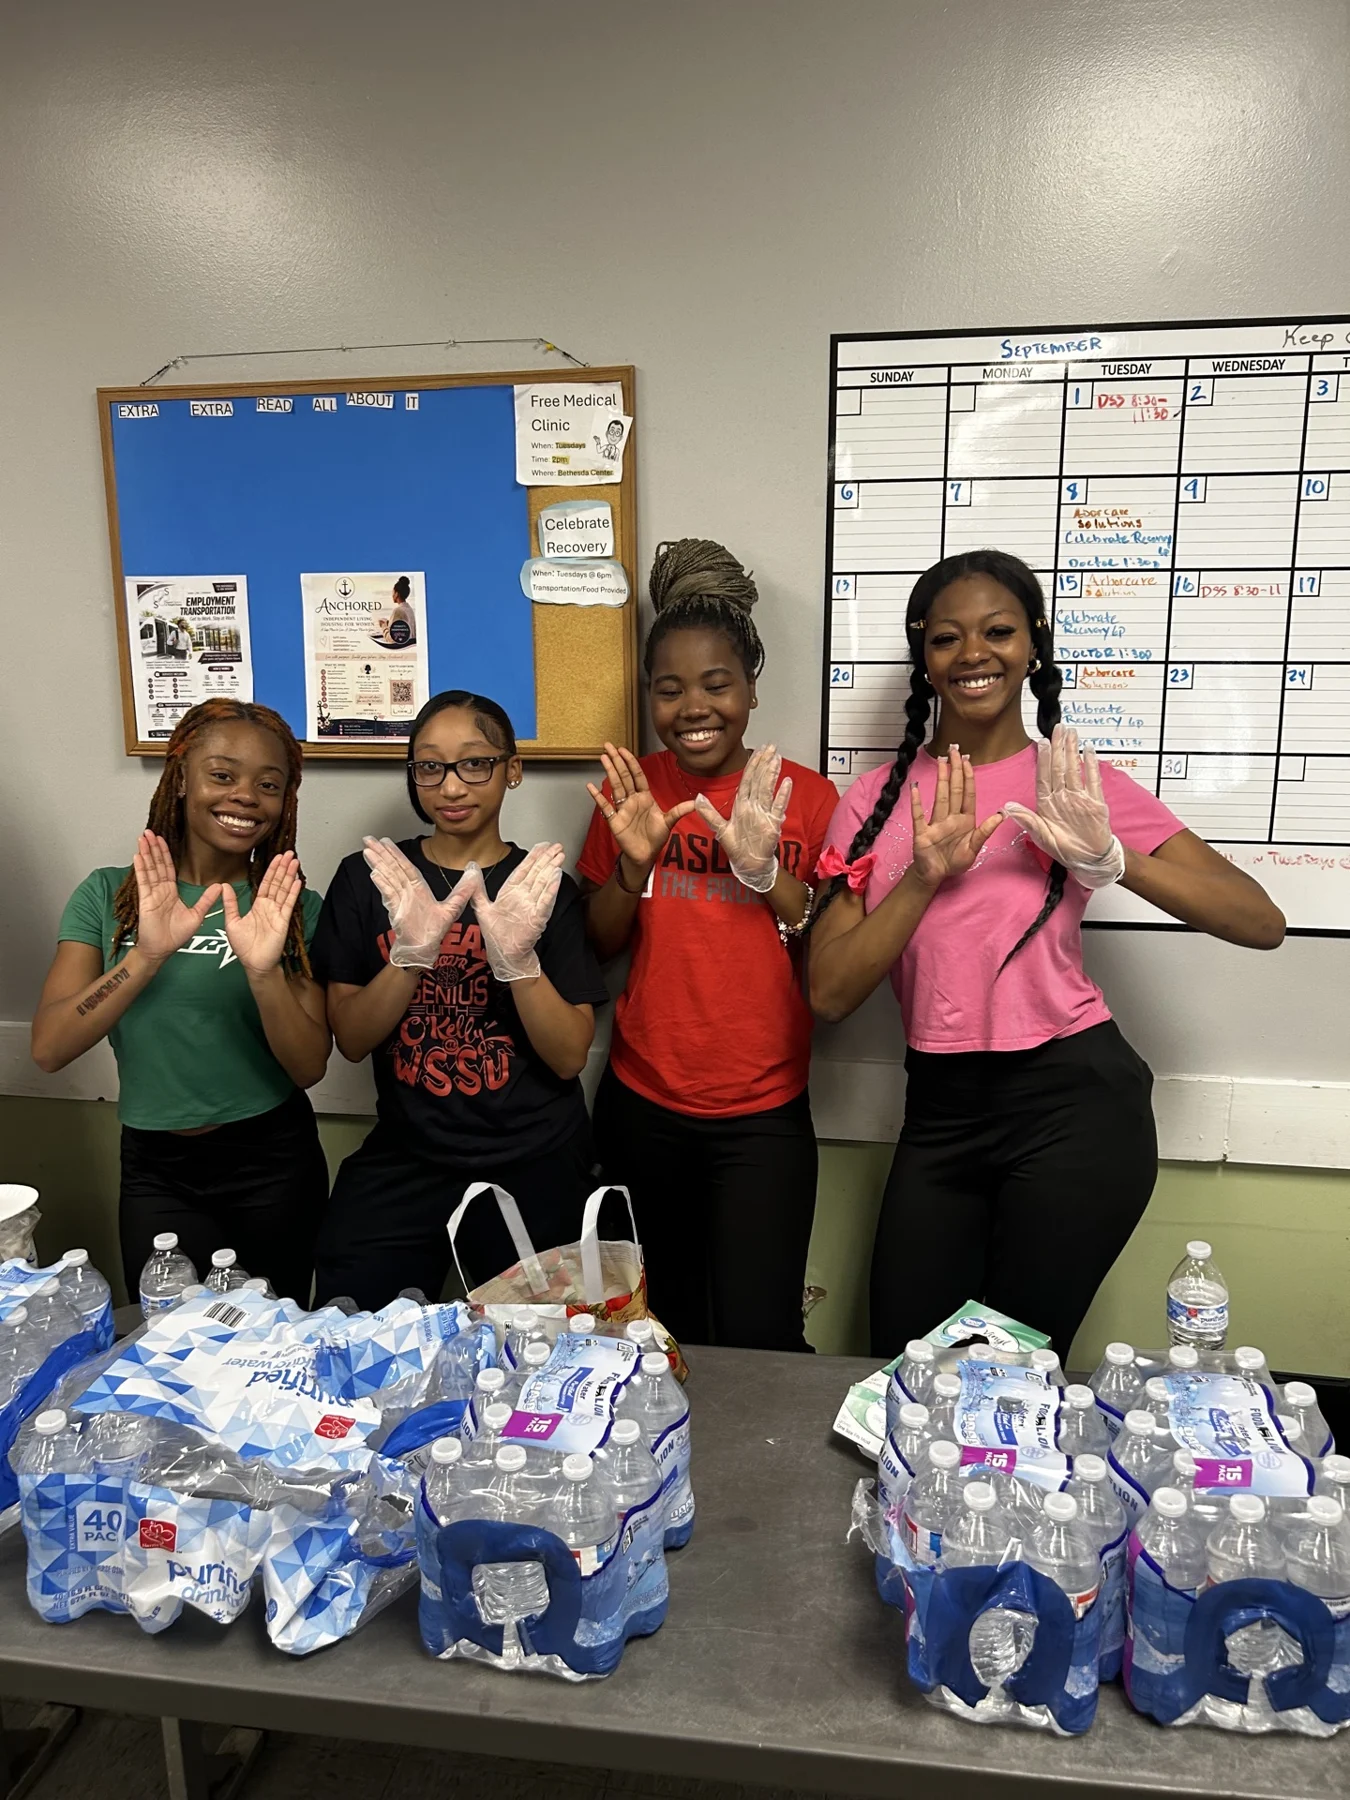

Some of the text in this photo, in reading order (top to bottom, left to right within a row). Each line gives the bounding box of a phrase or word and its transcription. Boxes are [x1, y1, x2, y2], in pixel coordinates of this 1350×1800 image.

[1283, 325, 1334, 351] Keep
[982, 367, 1033, 379] MONDAY
[1101, 363, 1152, 376] TUESDAY
[1212, 359, 1286, 372] WEDNESDAY
[870, 371, 914, 383] SUNDAY
[1190, 384, 1207, 401] 2
[1316, 379, 1329, 396] 3
[119, 393, 418, 417] EXTRA EXTRA READ ALL ABOUT IT
[531, 393, 617, 408] Free Medical
[531, 419, 570, 431] Clinic
[555, 442, 586, 450] Tuesdays
[552, 456, 568, 464] 2pm
[558, 469, 590, 477] Bethesda
[591, 469, 614, 477] Center
[841, 484, 853, 500] 6
[950, 483, 962, 501] 7
[1066, 482, 1078, 500] 8
[1184, 478, 1198, 499] 9
[1305, 479, 1325, 496] 10
[545, 517, 610, 531] Celebrate
[547, 541, 608, 555] Recovery
[532, 569, 555, 577] When:
[556, 570, 587, 579] Tuesdays
[597, 571, 612, 579] 6pm
[532, 584, 627, 594] Transportation/Food Provided
[836, 579, 850, 594] 13
[1059, 574, 1078, 591] 15
[1174, 575, 1194, 596] 16
[1299, 576, 1316, 593] 17
[1201, 586, 1227, 598] DSS
[186, 596, 236, 606] EMPLOYMENT
[180, 606, 236, 616] TRANSPORTATION
[1055, 609, 1120, 624] Celebrate
[831, 667, 850, 683] 20
[1065, 668, 1075, 682] 2
[1170, 668, 1189, 682] 23
[1287, 669, 1306, 685] 24
[1061, 701, 1126, 714] elebrate
[1163, 759, 1182, 774] 30
[660, 871, 699, 899] THE
[425, 1006, 469, 1016] WITH
[443, 1036, 459, 1055] @
[394, 1045, 510, 1096] WSSU
[983, 1329, 1011, 1346] Vinyl
[222, 1357, 273, 1368] water
[580, 1381, 594, 1400] Water
[524, 1417, 540, 1433] PACK
[533, 1418, 552, 1433] 15
[657, 1440, 674, 1466] LION
[985, 1451, 993, 1466] PACK
[992, 1453, 1008, 1467] 15
[881, 1451, 899, 1478] LION
[1218, 1464, 1226, 1482] PACK
[1226, 1465, 1242, 1481] 15
[1112, 1484, 1139, 1512] LION
[83, 1509, 122, 1532] 40
[84, 1532, 118, 1542] PAC
[167, 1560, 251, 1594] purifi
